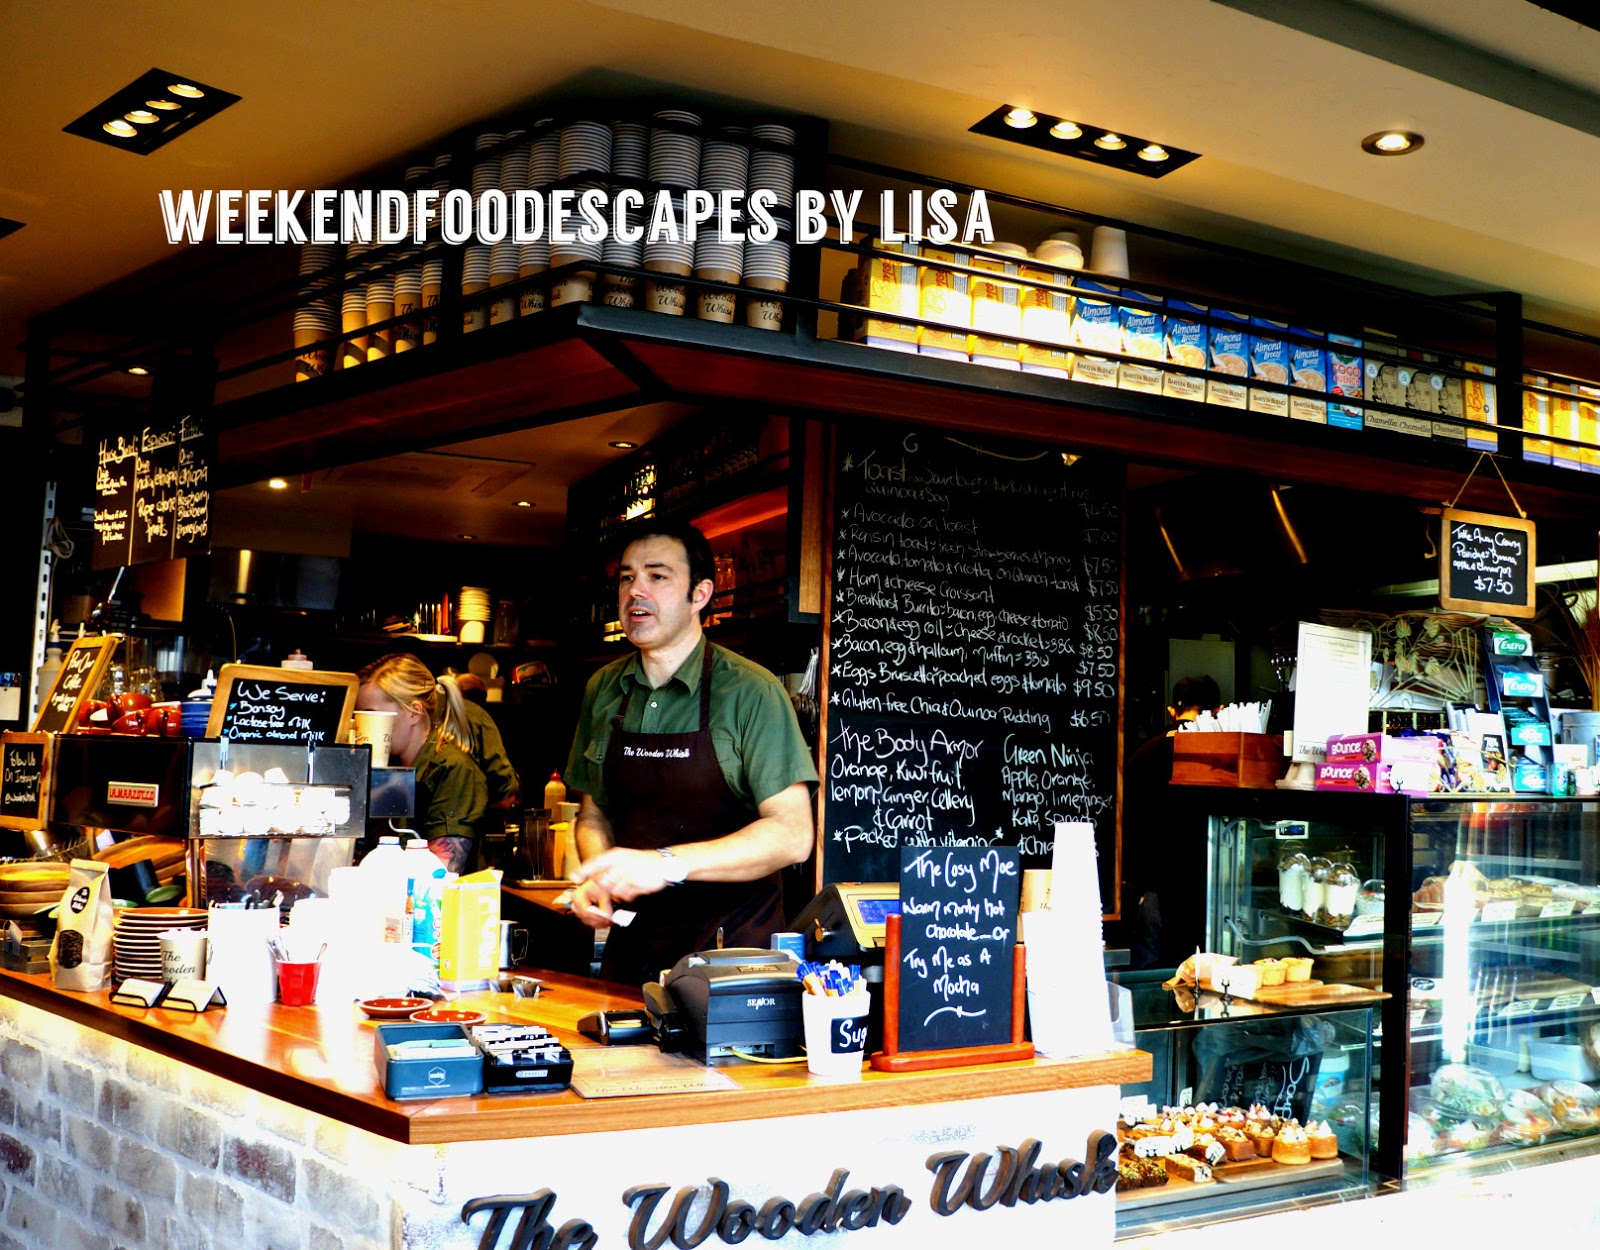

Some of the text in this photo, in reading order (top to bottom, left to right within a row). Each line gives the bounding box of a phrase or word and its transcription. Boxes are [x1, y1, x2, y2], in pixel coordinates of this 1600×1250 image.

[1081, 304, 1113, 319] Almond
[1126, 314, 1156, 328] Almond
[1171, 323, 1201, 336] Almond
[1214, 333, 1242, 344] Almond
[1254, 341, 1281, 353] Almond
[1294, 348, 1320, 360] Almond
[853, 500, 915, 530] Avocado
[941, 515, 979, 536] toast
[849, 523, 895, 549] Raisin
[1451, 523, 1474, 542] Take
[849, 564, 881, 593] Ham
[1473, 575, 1514, 595] $7.50
[844, 587, 899, 611] Breakfast
[1500, 641, 1526, 652] Extra
[842, 660, 878, 687] Eggs
[990, 674, 1021, 695] eggs
[1072, 677, 1117, 699] $9.50
[1510, 681, 1536, 692] Extra
[237, 681, 327, 704] We Serve:
[236, 700, 286, 721] Bonsoy
[998, 706, 1052, 734] Pudding
[623, 746, 635, 757] The
[635, 747, 665, 759] Wooden
[874, 727, 930, 769] Body
[929, 729, 985, 770] Armor
[1002, 732, 1095, 780] Green Ninja
[904, 829, 938, 847] with
[904, 849, 1018, 894] The Cosy Moe
[902, 896, 941, 921] Warm
[984, 897, 1006, 918] hot
[163, 950, 181, 963] The
[903, 945, 993, 979] Try Me as A
[163, 962, 196, 976] ooden
[932, 973, 981, 1003] Mocha
[461, 1128, 1120, 1250] The Wooden Whisk
